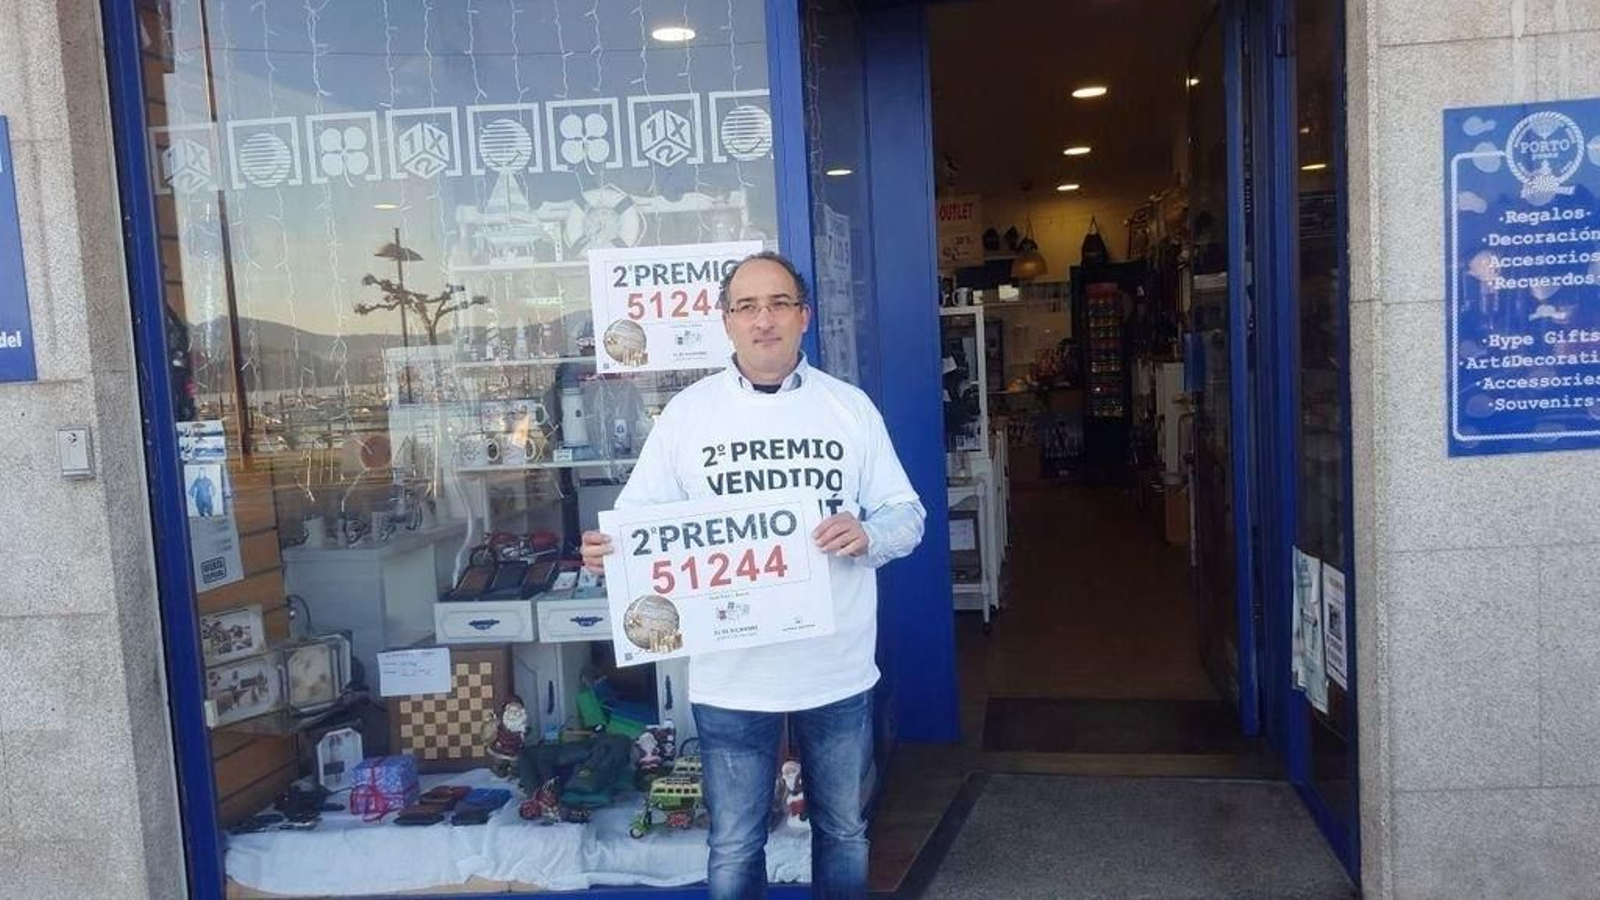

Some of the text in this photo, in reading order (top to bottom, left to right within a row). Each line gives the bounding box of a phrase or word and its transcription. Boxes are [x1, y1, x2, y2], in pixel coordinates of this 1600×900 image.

[1521, 138, 1570, 154] PORTO
[939, 202, 974, 221] OUTLET
[0, 330, 22, 348] del
[731, 438, 844, 462] PREMIO
[707, 467, 843, 496] VENDIDO
[659, 510, 798, 552] PREMIO
[652, 545, 788, 595] 51244
